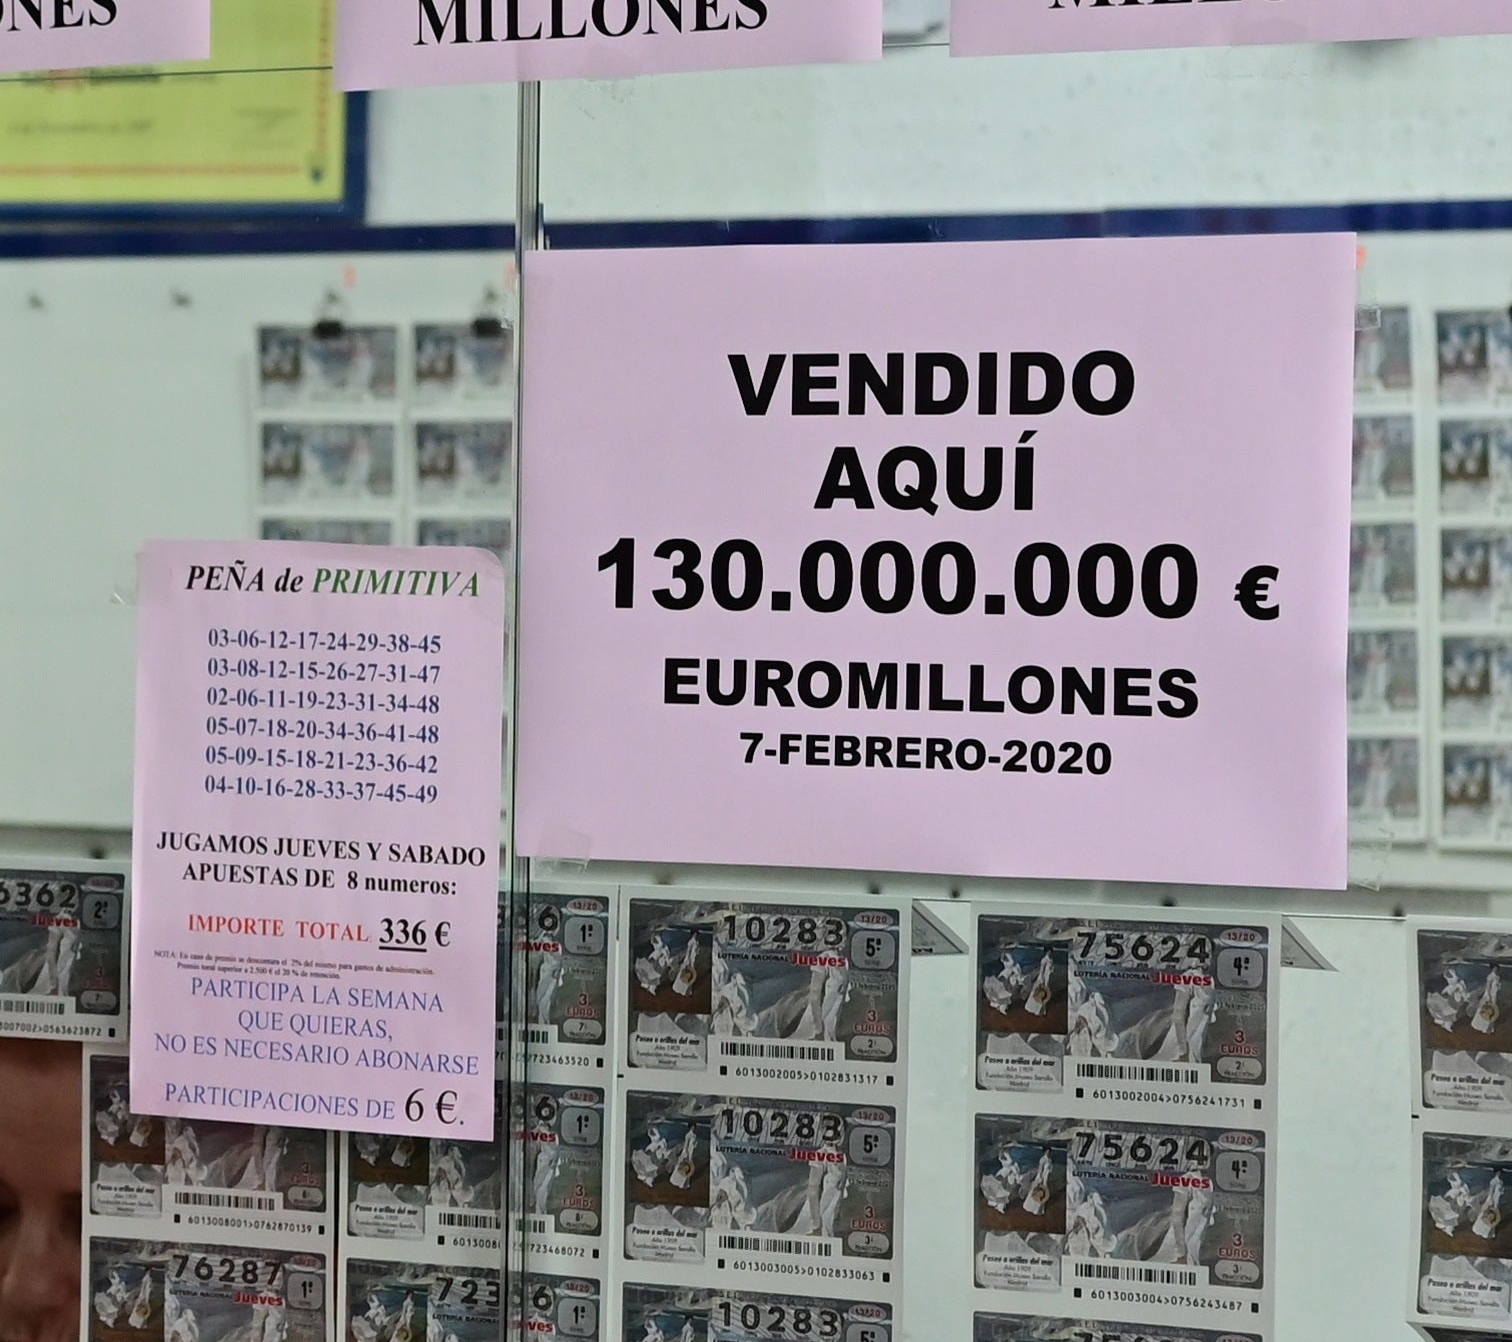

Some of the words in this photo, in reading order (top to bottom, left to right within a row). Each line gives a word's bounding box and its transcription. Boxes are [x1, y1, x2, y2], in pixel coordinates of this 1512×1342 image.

[727, 349, 1136, 417] VENDIDO
[813, 429, 1038, 517] AQUÍ
[184, 559, 265, 593] PEÑA
[274, 567, 305, 594] de
[312, 567, 480, 598] PRIMITIVA
[596, 537, 1199, 621] 130.000.000
[1234, 564, 1281, 621] €
[208, 627, 442, 655] 03-06-12-17-24-29-38-45
[207, 657, 441, 685] 03-08-12-15-26-27-31-47
[663, 656, 1201, 719] EUROMILLONES
[206, 686, 440, 715] 02-06-11-19-23-31-34-48
[739, 731, 1113, 777] 7-FEBRERO-2020
[156, 830, 268, 857] JUGAMOS
[273, 837, 360, 861] JUEVES
[366, 842, 383, 861] Y
[388, 844, 486, 867] SABADO
[182, 862, 298, 888] APUESTAS
[305, 868, 335, 889] DE
[347, 870, 358, 890] 8
[365, 875, 458, 896] numeros:
[188, 913, 285, 938] IMPORTE
[379, 917, 428, 947] 336
[435, 921, 452, 948] €
[724, 916, 844, 945] 10283
[1077, 932, 1210, 963] 75624
